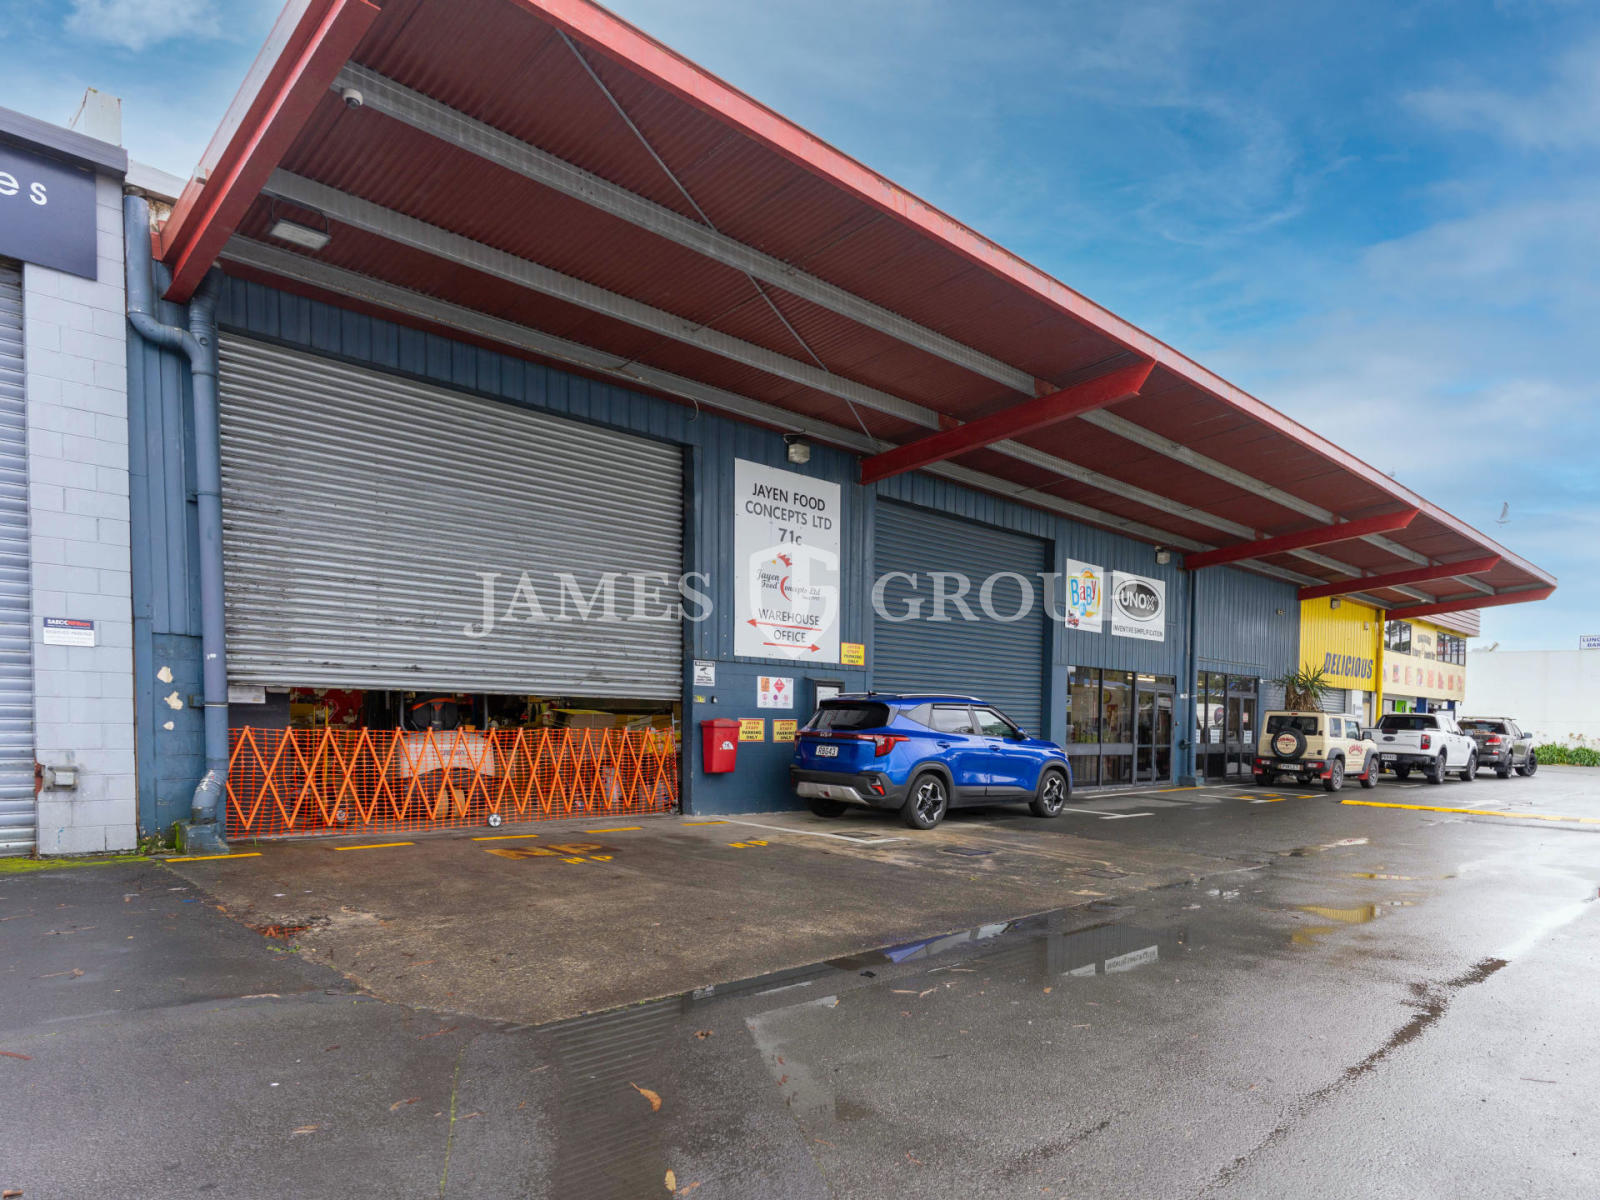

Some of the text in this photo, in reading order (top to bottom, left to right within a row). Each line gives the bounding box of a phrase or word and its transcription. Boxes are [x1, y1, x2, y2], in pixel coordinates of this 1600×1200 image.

[752, 483, 826, 511] JAYEN FOOD
[745, 500, 833, 530] CONCEPTS LTD
[1121, 590, 1156, 611] UNOX
[758, 608, 820, 626] WAREHOUSE
[773, 629, 806, 643] OFFICE
[1324, 652, 1374, 679] DELICIOUS
